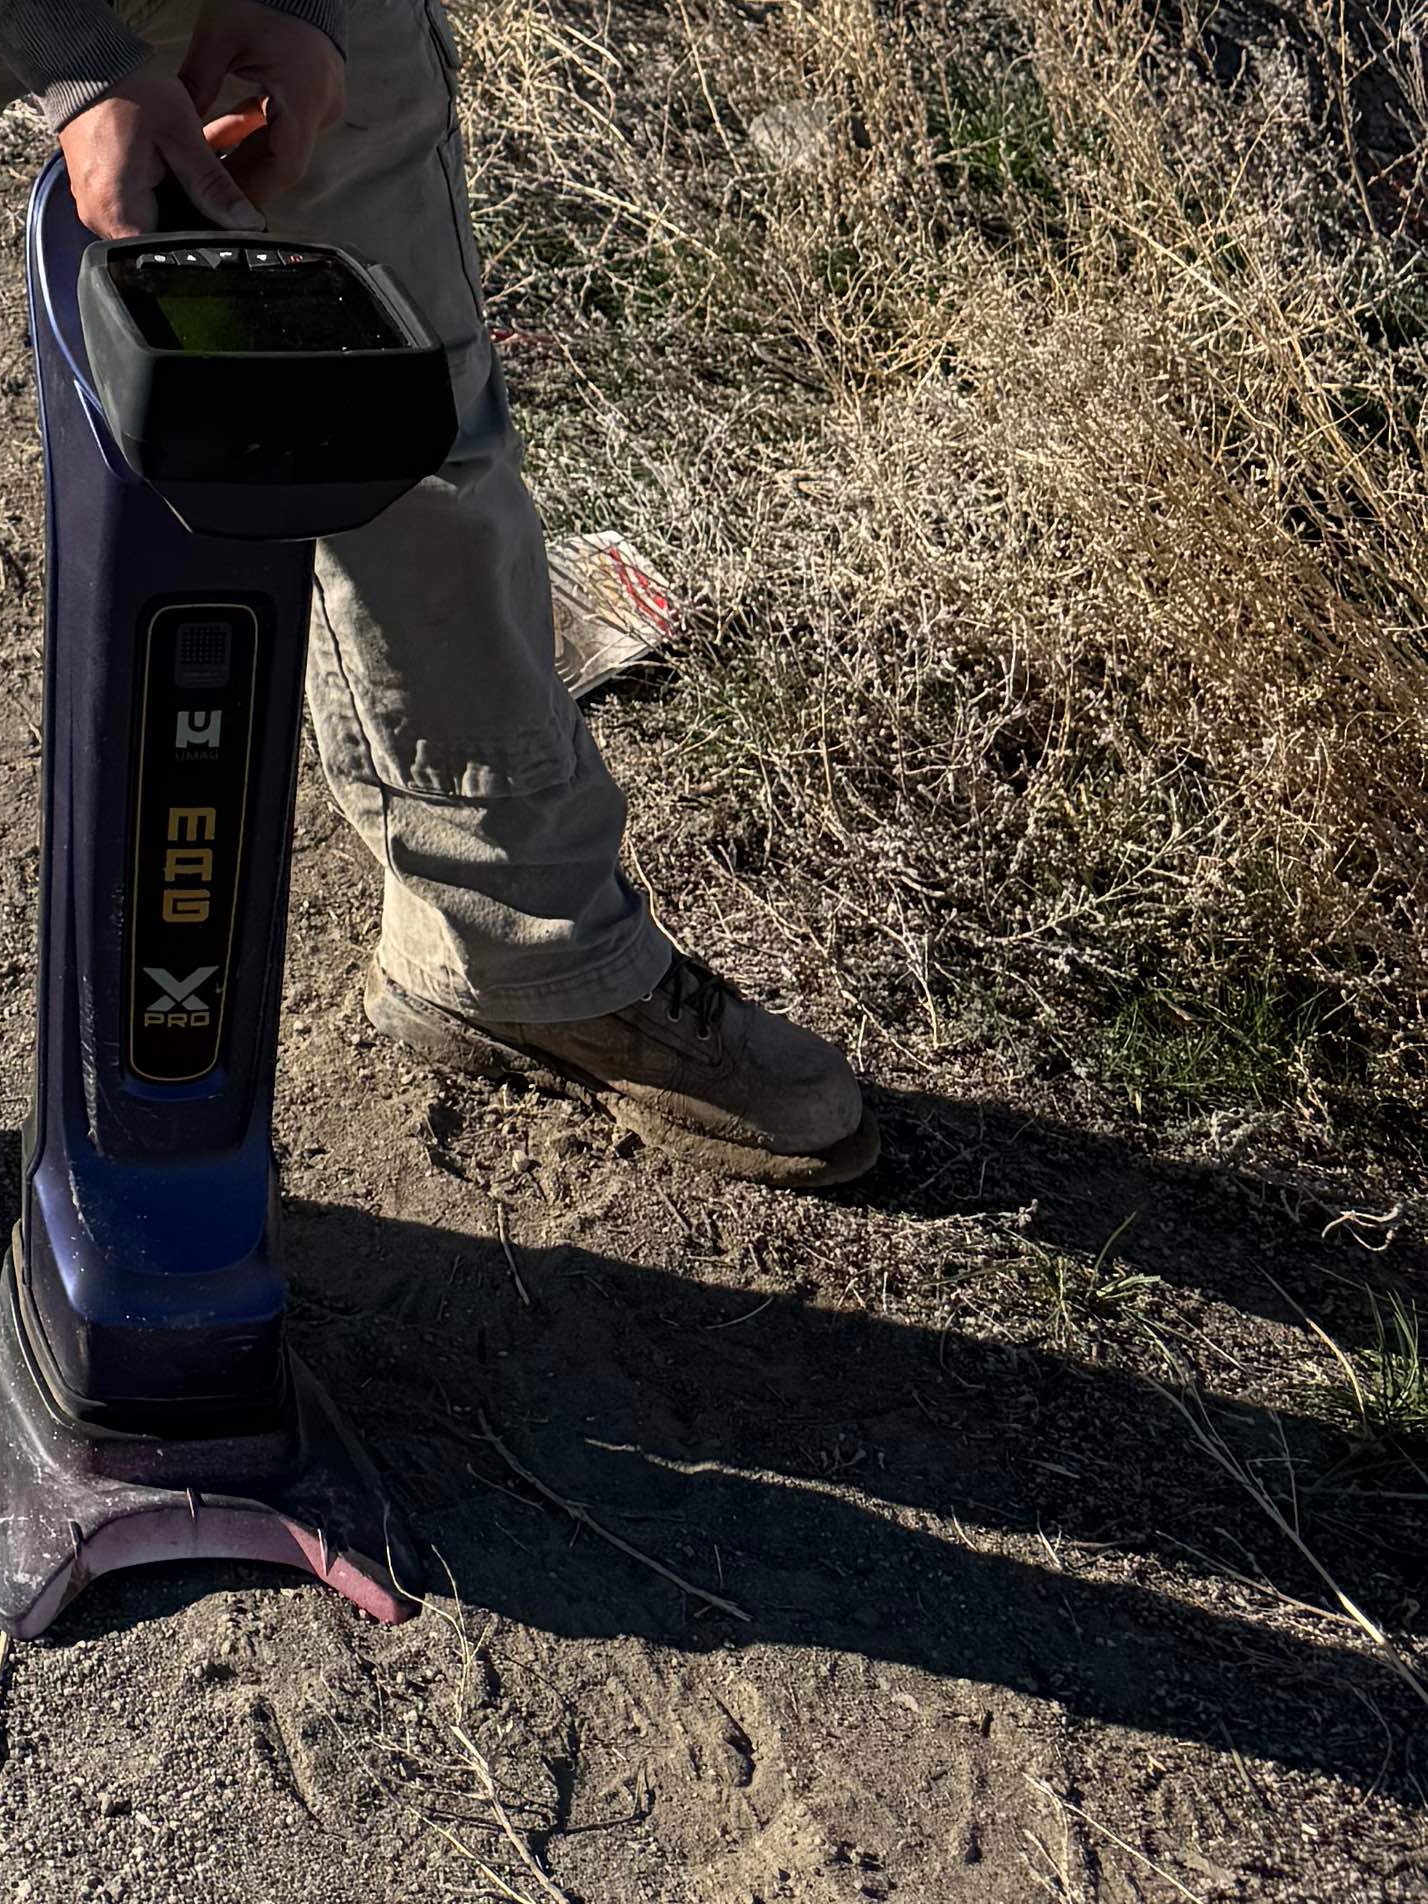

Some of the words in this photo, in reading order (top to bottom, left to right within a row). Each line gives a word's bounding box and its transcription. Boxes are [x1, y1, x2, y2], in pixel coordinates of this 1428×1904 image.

[161, 807, 217, 923] MAG
[142, 965, 221, 1012] X
[143, 1011, 211, 1028] PRO
